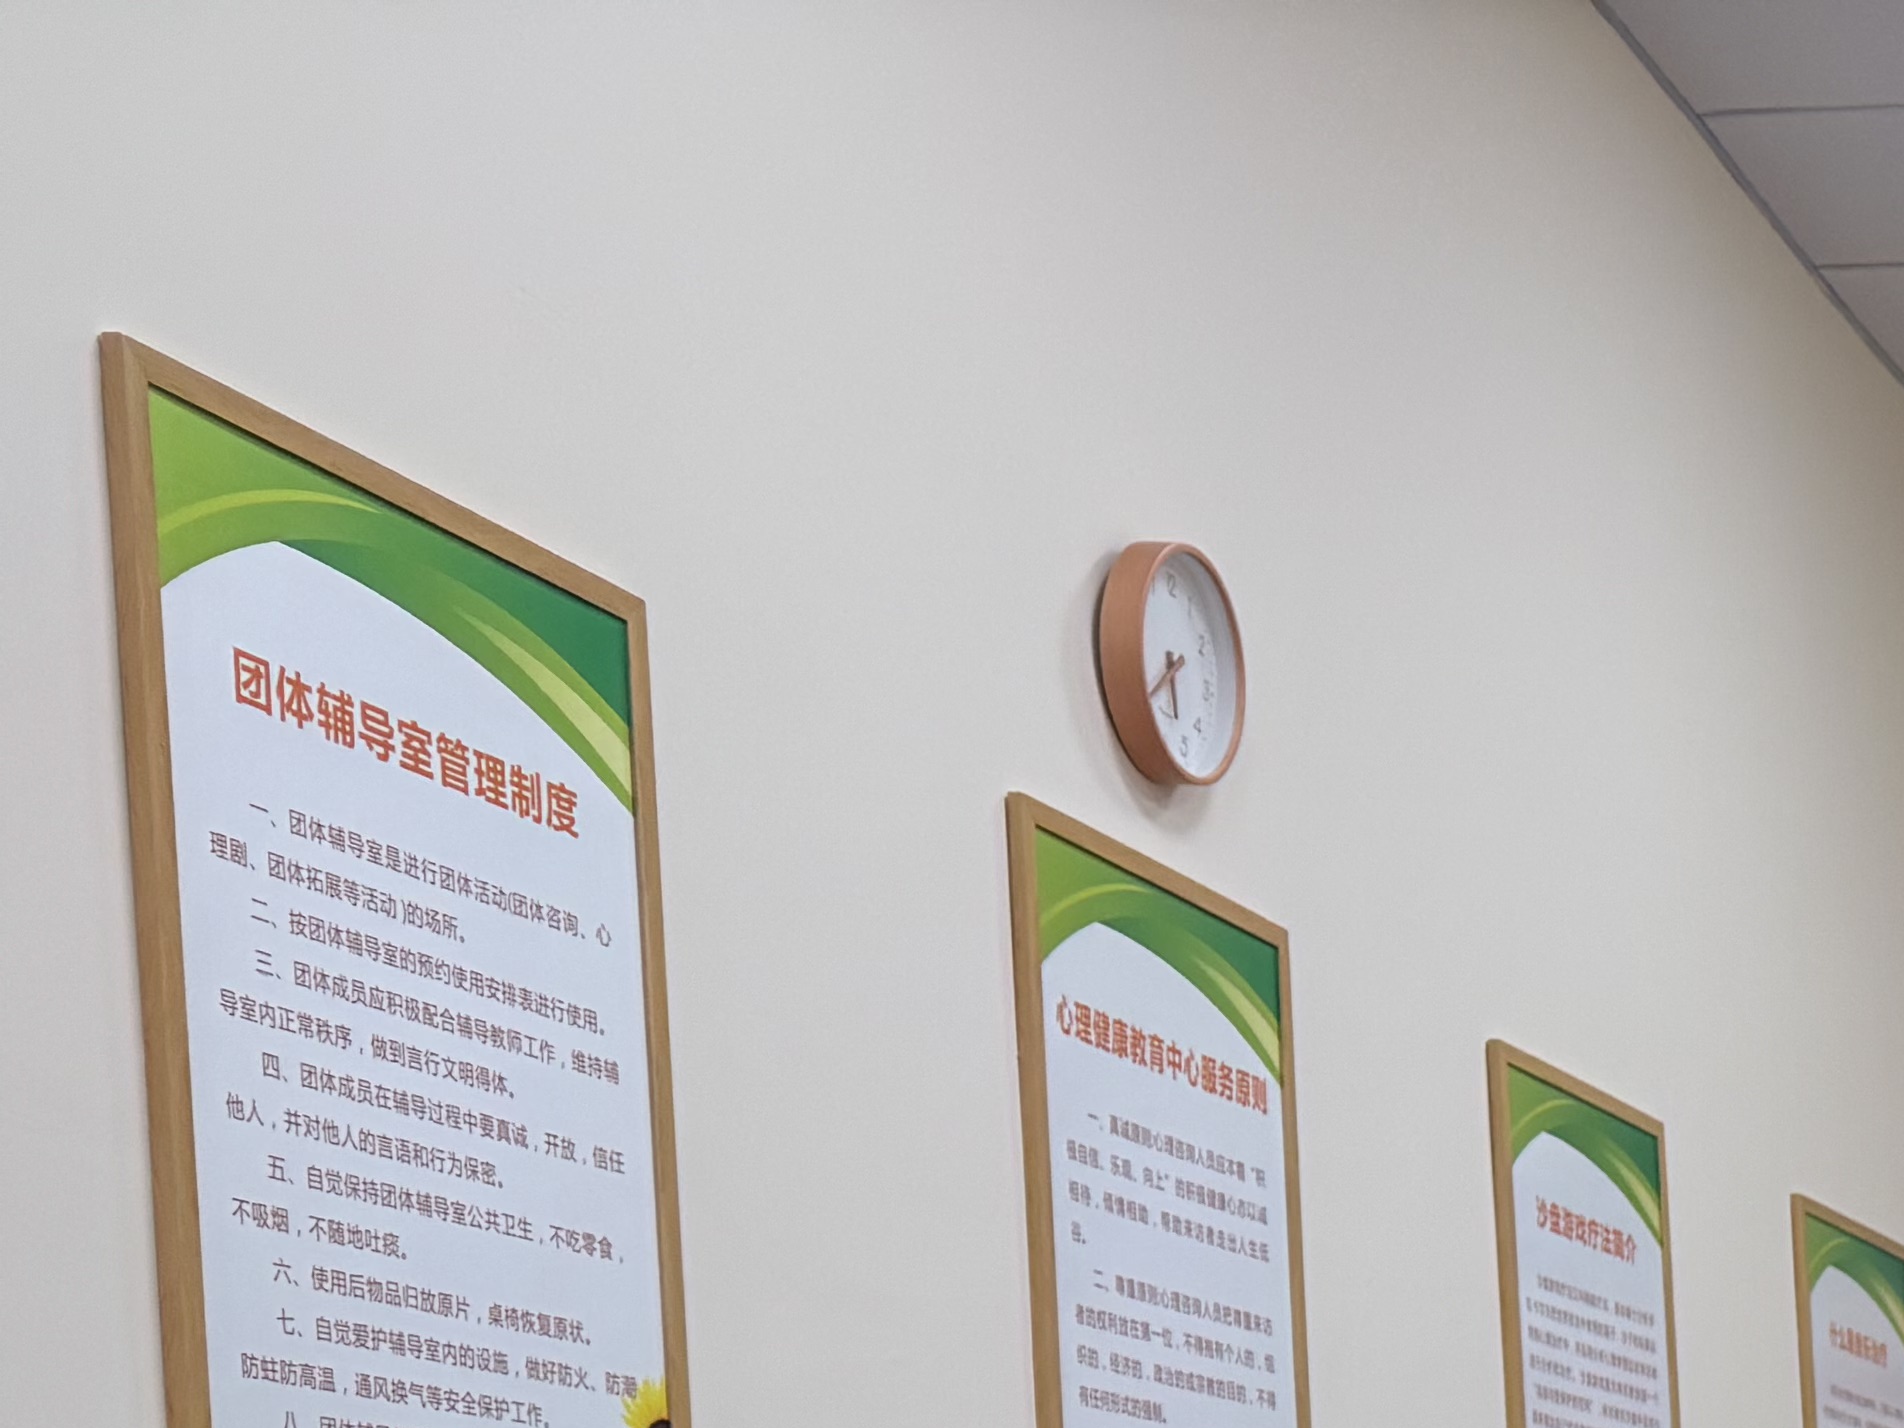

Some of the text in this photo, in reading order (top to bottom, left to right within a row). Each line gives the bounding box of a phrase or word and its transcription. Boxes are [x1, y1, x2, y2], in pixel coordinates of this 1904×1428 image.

[233, 648, 580, 839] 团体辅导室管理制度
